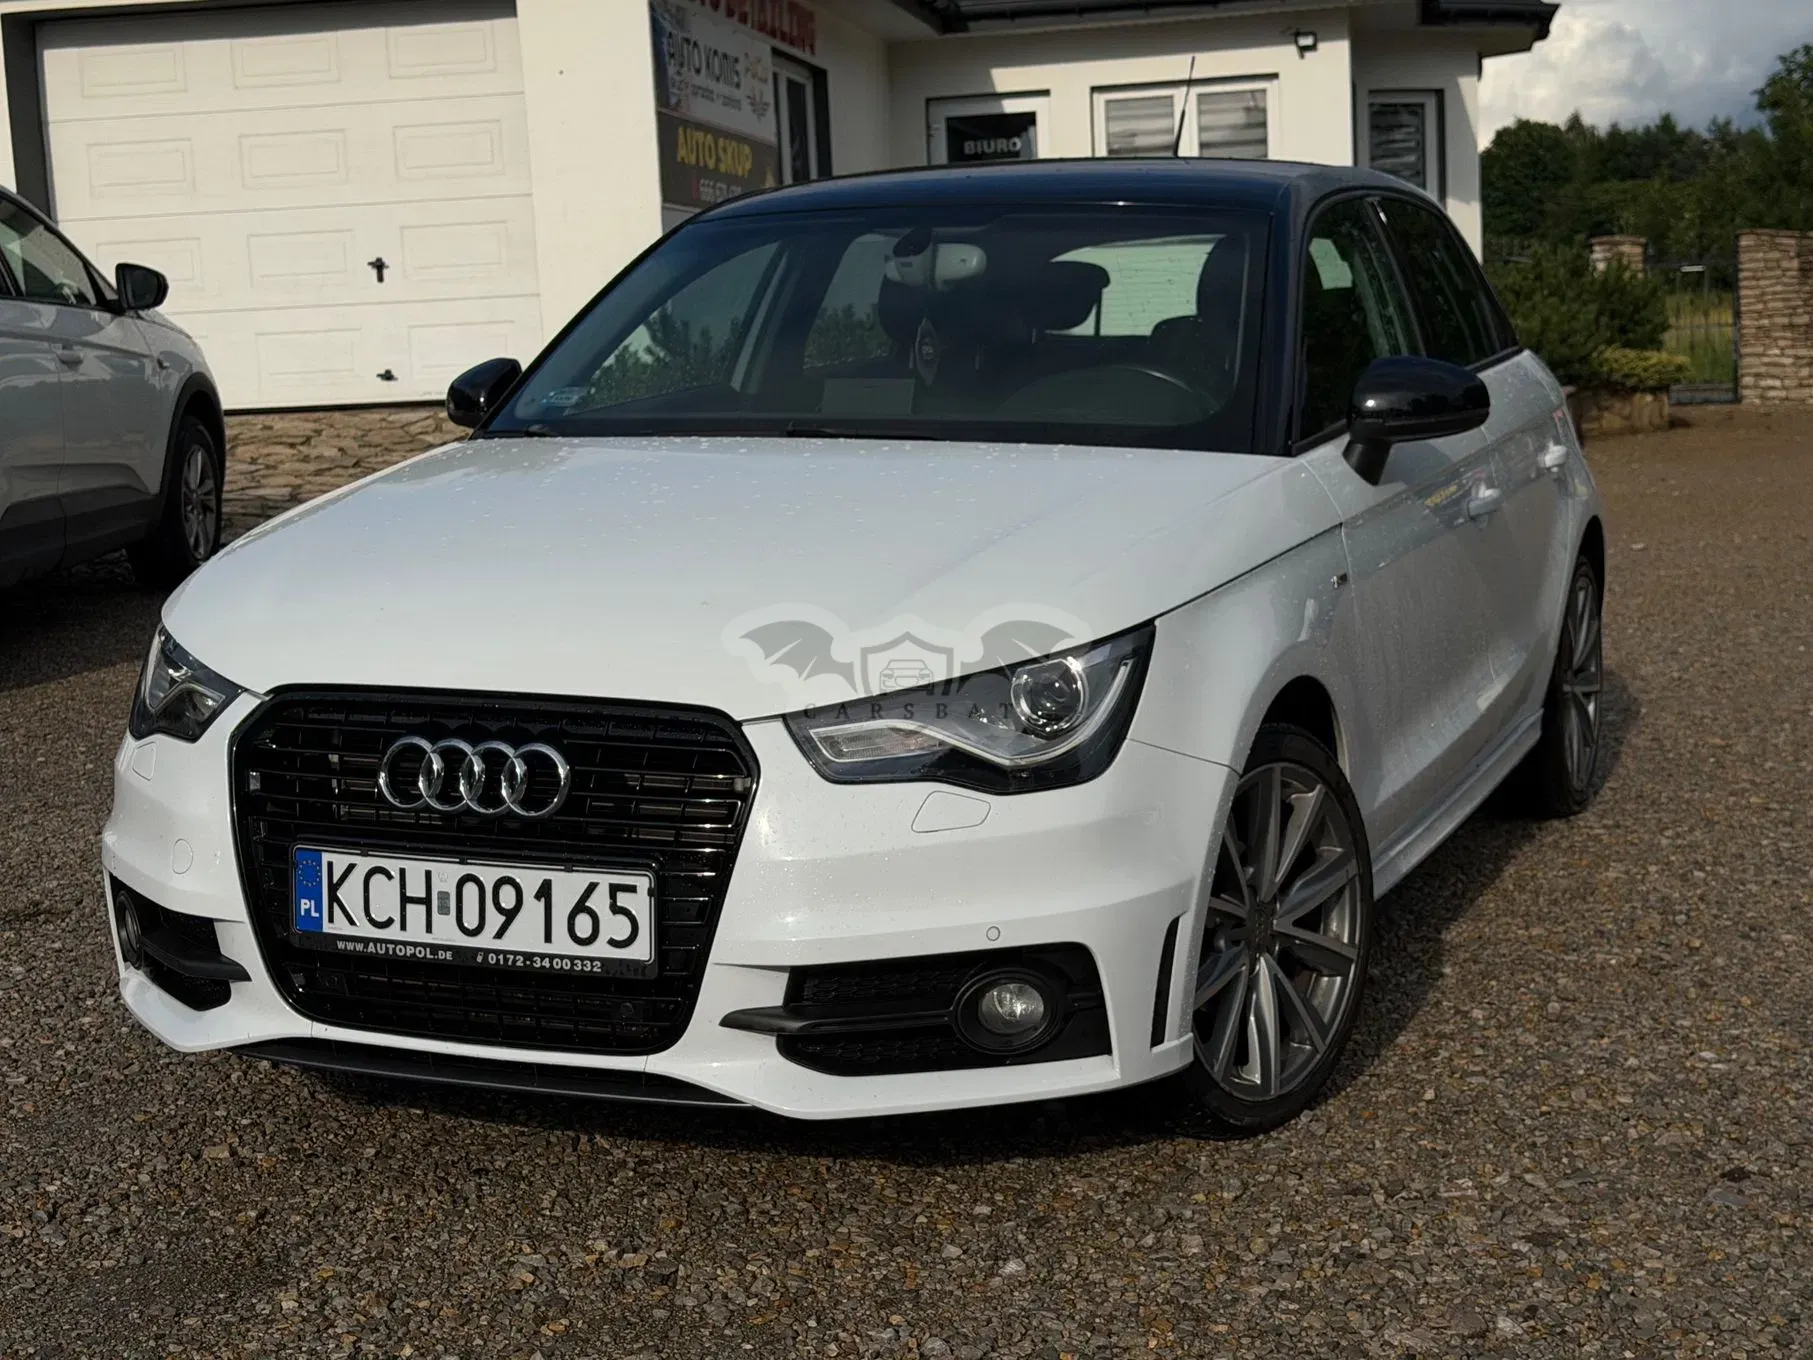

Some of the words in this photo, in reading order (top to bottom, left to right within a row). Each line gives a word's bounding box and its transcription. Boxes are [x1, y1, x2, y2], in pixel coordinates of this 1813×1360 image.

[677, 126, 716, 169] AUTO
[719, 137, 753, 178] SKUP
[964, 136, 1022, 155] BIURO
[300, 898, 320, 918] PL
[326, 860, 433, 935] KCH
[455, 872, 640, 950] 09165
[336, 940, 453, 961] WWW.AUTOPOL.DE
